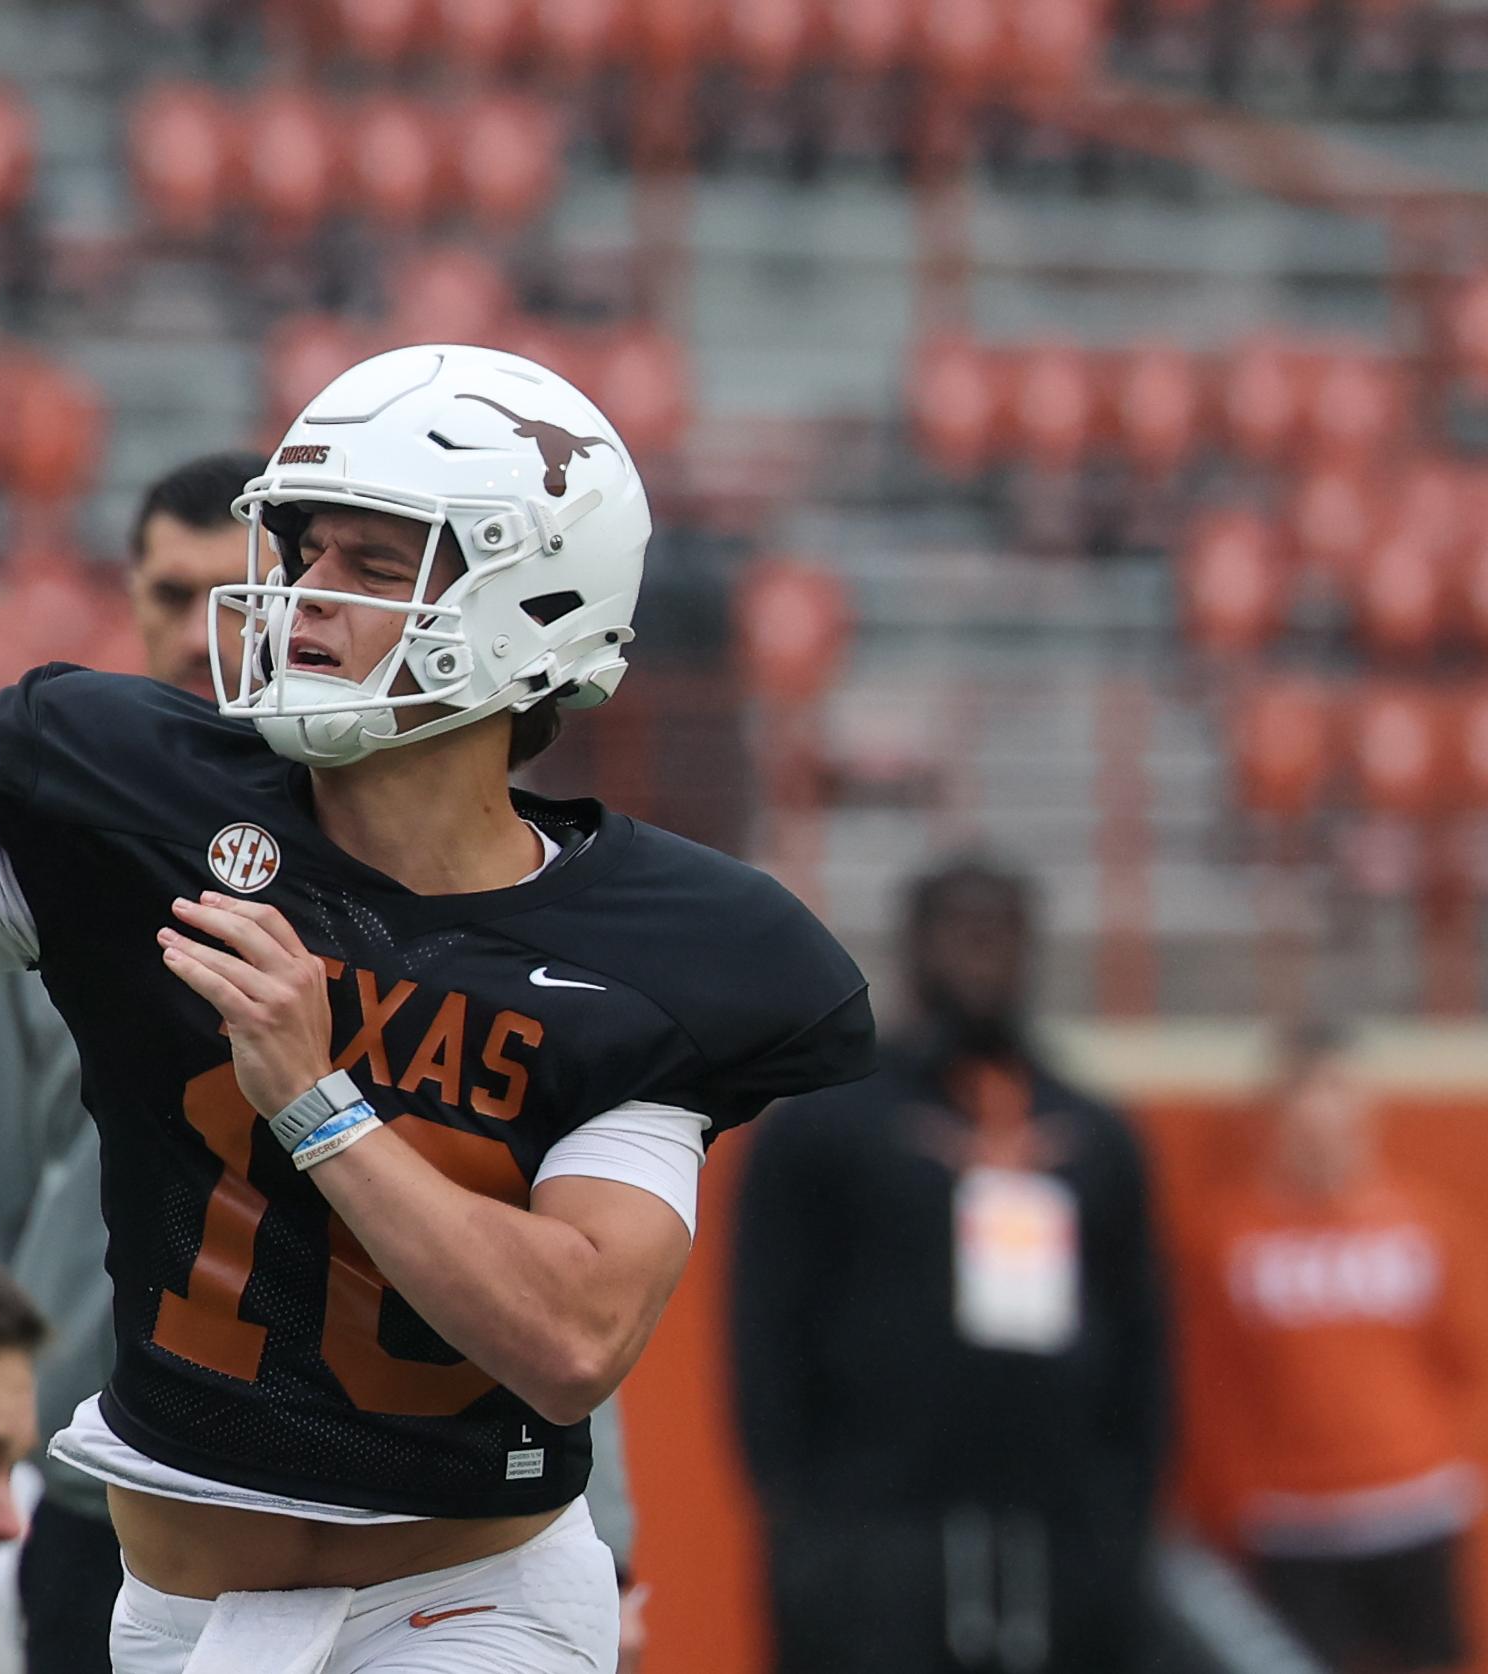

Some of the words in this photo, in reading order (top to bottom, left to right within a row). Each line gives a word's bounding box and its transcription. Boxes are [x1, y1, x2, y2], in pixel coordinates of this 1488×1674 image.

[211, 825, 277, 889] SEC
[219, 955, 544, 1121] XAS
[522, 1424, 532, 1443] L
